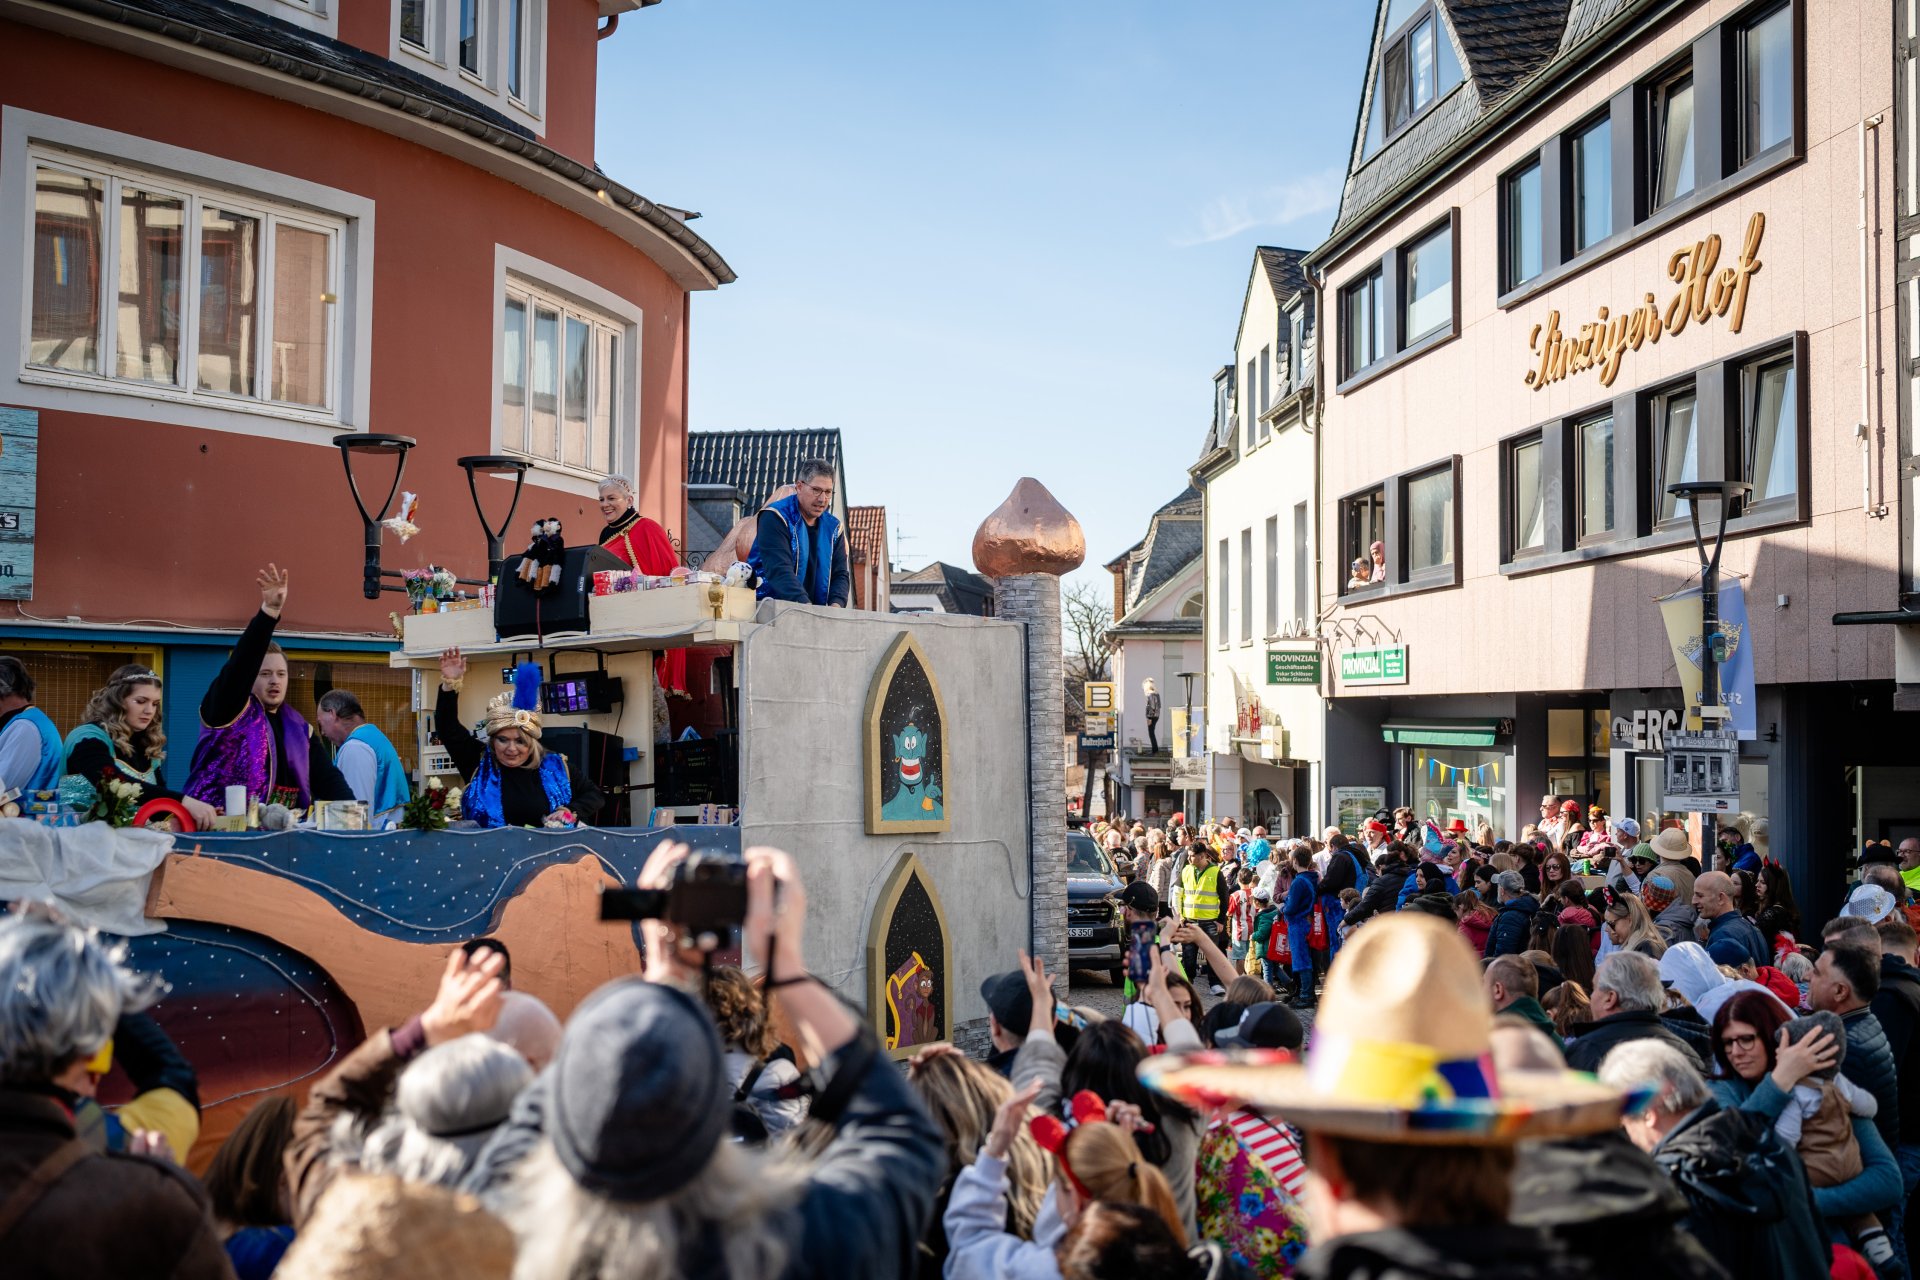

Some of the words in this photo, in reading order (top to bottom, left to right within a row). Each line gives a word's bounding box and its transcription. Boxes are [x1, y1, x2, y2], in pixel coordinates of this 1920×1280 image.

[1525, 292, 1662, 391] Sinziger
[1664, 212, 1765, 334] Hof
[1270, 654, 1319, 663] PROVINZIAL
[1343, 657, 1380, 675] PROVINZIAL
[1077, 928, 1093, 937] 350
